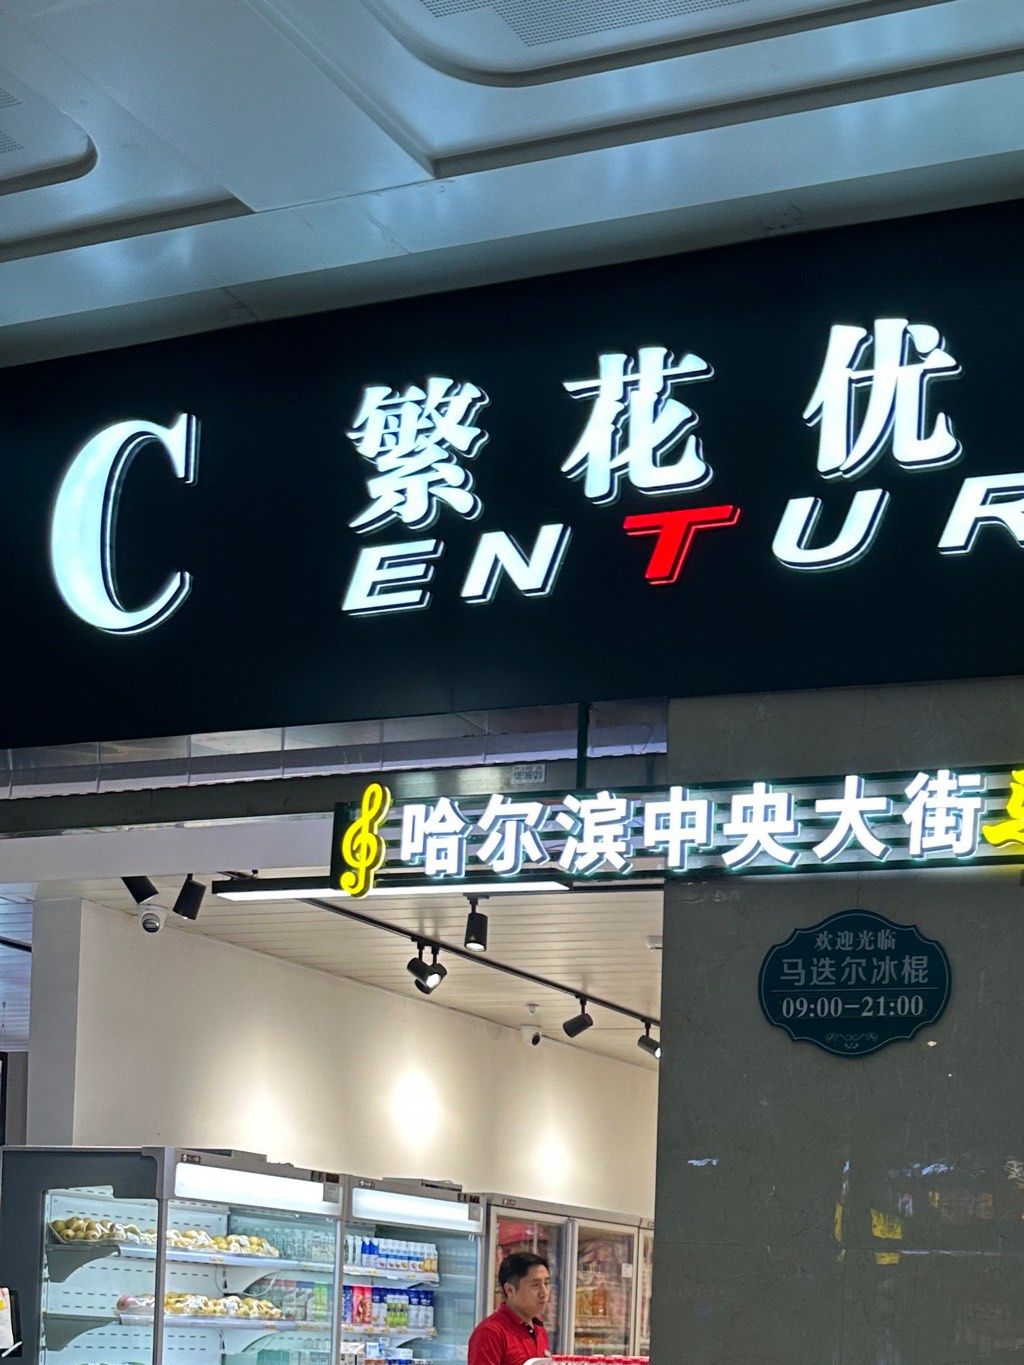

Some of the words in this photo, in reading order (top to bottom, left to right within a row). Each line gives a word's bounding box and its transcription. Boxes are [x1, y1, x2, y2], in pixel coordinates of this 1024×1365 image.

[814, 929, 897, 951] 欢迎光临
[780, 954, 929, 986] 马迭尔冰棍
